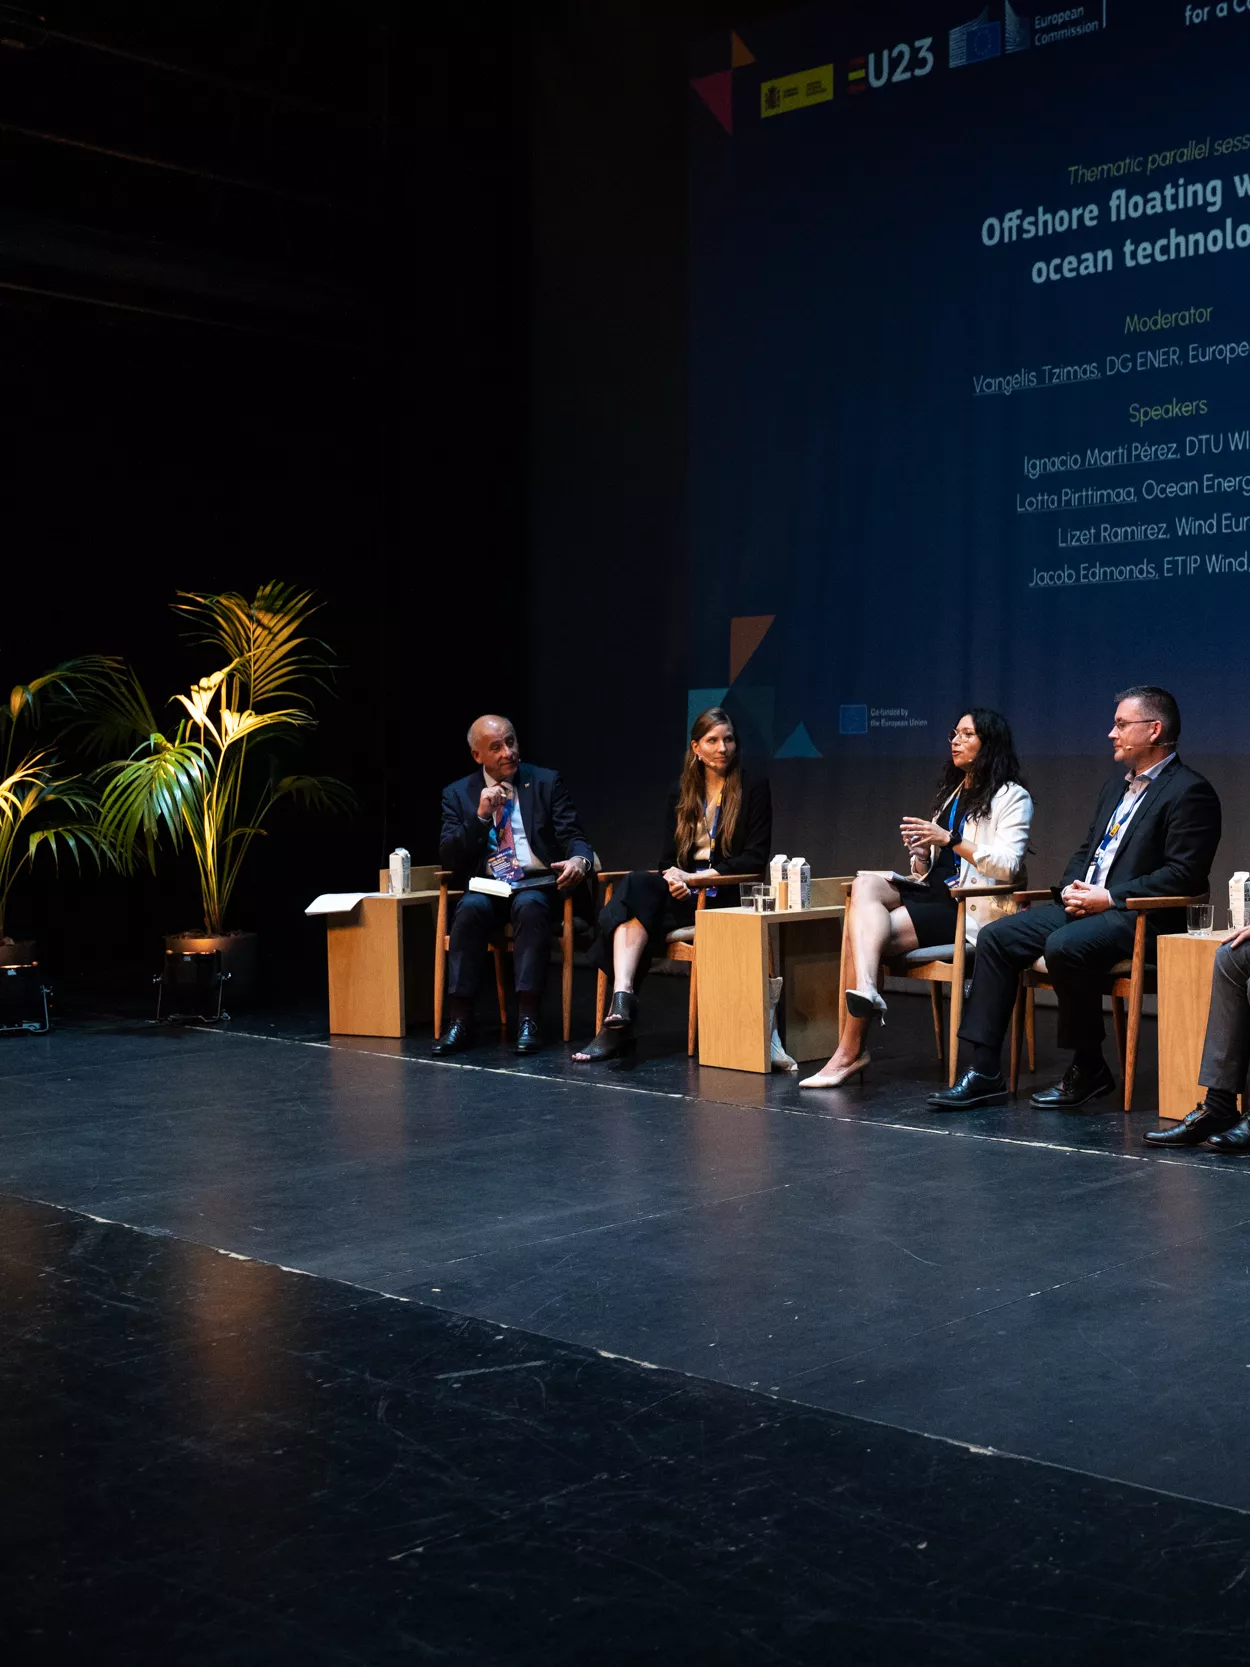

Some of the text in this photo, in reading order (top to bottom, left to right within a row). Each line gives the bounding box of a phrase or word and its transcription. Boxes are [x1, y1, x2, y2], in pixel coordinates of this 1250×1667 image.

[1034, 6, 1085, 30] European
[1184, 4, 1211, 26] for
[1215, 1, 1229, 18] a
[1034, 20, 1099, 46] Commission
[1068, 157, 1143, 186] Thematic
[1147, 142, 1210, 175] parallel
[981, 204, 1099, 247] Offshore
[1109, 177, 1223, 223] floating
[1031, 248, 1113, 284] ocean
[1124, 304, 1214, 336] Moderator
[972, 369, 1037, 397] Vangelis
[1042, 362, 1101, 385] Tzimas,
[1106, 353, 1132, 376] DG
[1136, 347, 1184, 371] ENER,
[1128, 397, 1209, 428] Speakers
[1024, 452, 1081, 479] Ignacio
[1131, 440, 1180, 461] Pérez,
[1185, 433, 1223, 457] DTU
[1016, 491, 1057, 513] Lotta
[1061, 484, 1138, 508] Pirttimaa,
[1142, 479, 1199, 500] Ocean
[1057, 526, 1096, 548] Lizet
[1175, 512, 1217, 537] Wind
[1028, 563, 1076, 587] Jacob
[1079, 558, 1160, 583] Edmonds,
[1163, 555, 1200, 577] ETIP
[881, 718, 908, 728] European
[909, 717, 928, 727] Union
